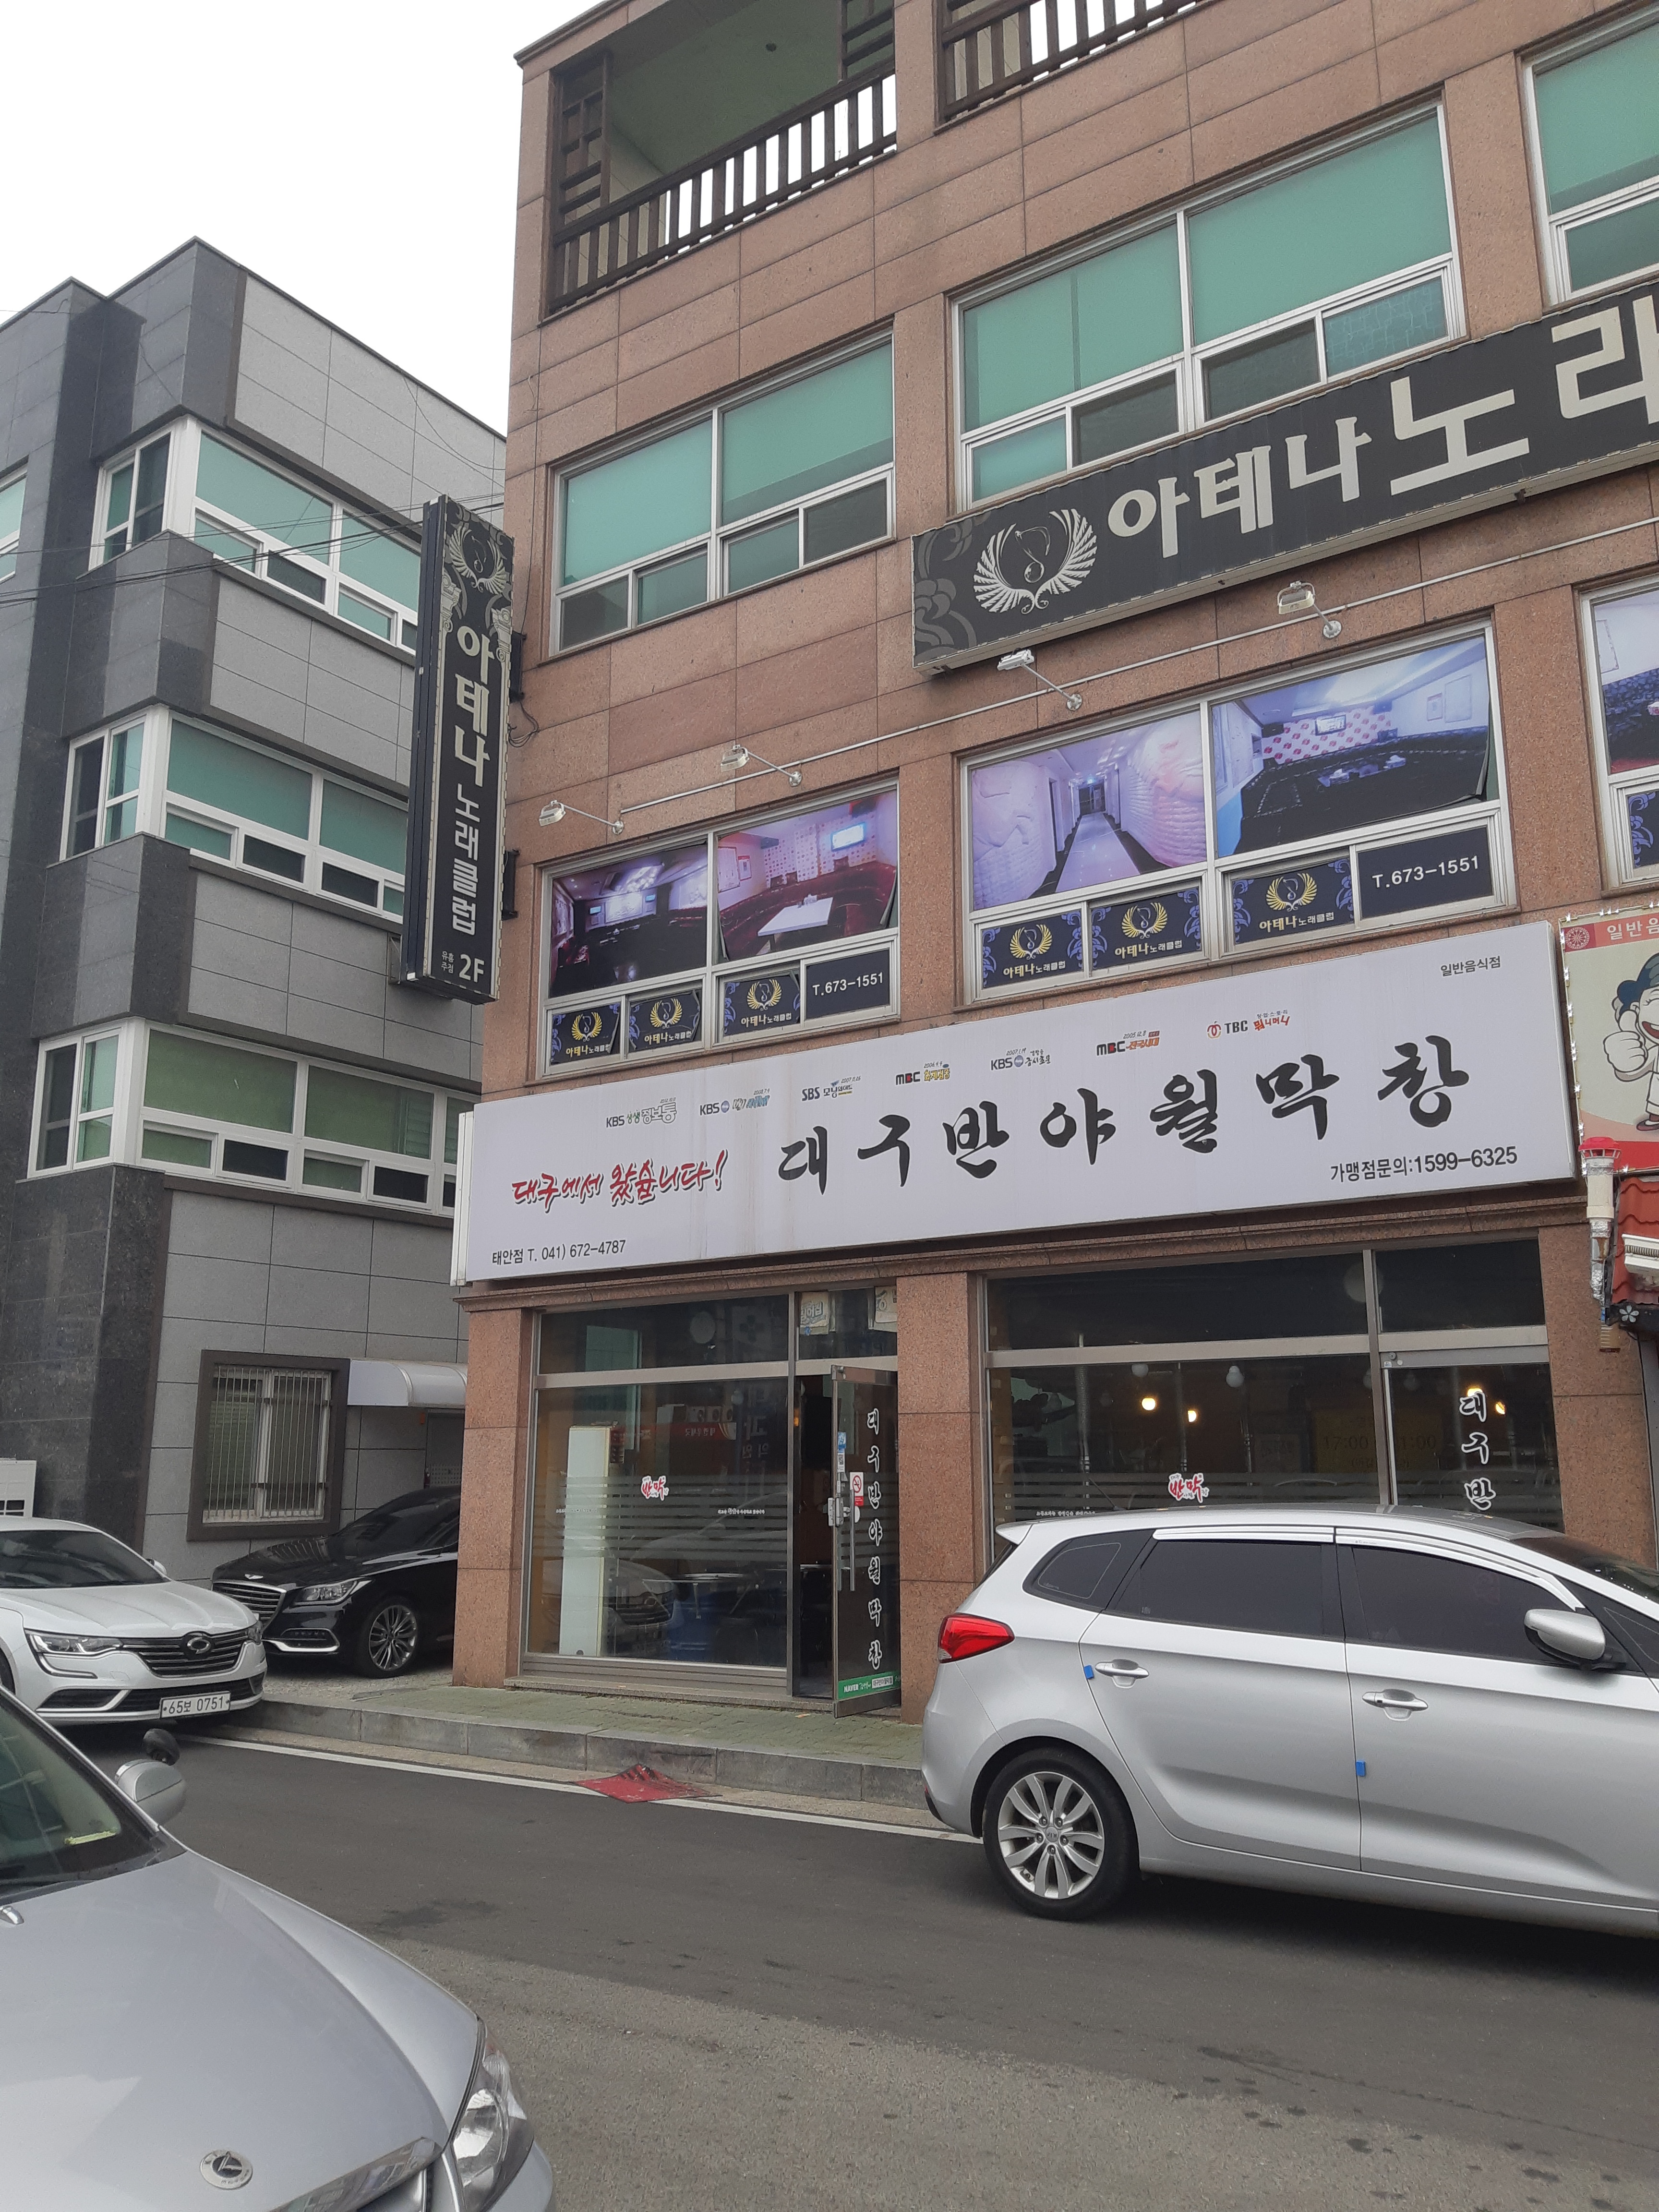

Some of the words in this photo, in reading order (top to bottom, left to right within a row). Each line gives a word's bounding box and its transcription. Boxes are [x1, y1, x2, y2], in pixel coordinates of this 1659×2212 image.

[1372, 855, 1480, 889] T.673-1551
[459, 954, 484, 983] 2F
[1440, 956, 1502, 978] 일반음식점
[812, 973, 884, 997] T.673-1551
[1224, 1020, 1248, 1034] TBC
[1097, 1041, 1126, 1056] MBC
[991, 1058, 1012, 1070] KBS
[896, 1071, 920, 1085] MBC
[802, 1087, 820, 1101] SBS
[700, 1103, 720, 1115] KBS
[606, 1116, 625, 1128] KBS
[512, 1172, 604, 1214] 대구에서
[492, 1248, 524, 1265] 태안점
[541, 1244, 566, 1261] 041)
[570, 1239, 626, 1259] 672-4787
[844, 1684, 859, 1693] NAVER
[168, 1700, 192, 1714] 65보
[197, 1695, 223, 1711] 0751
